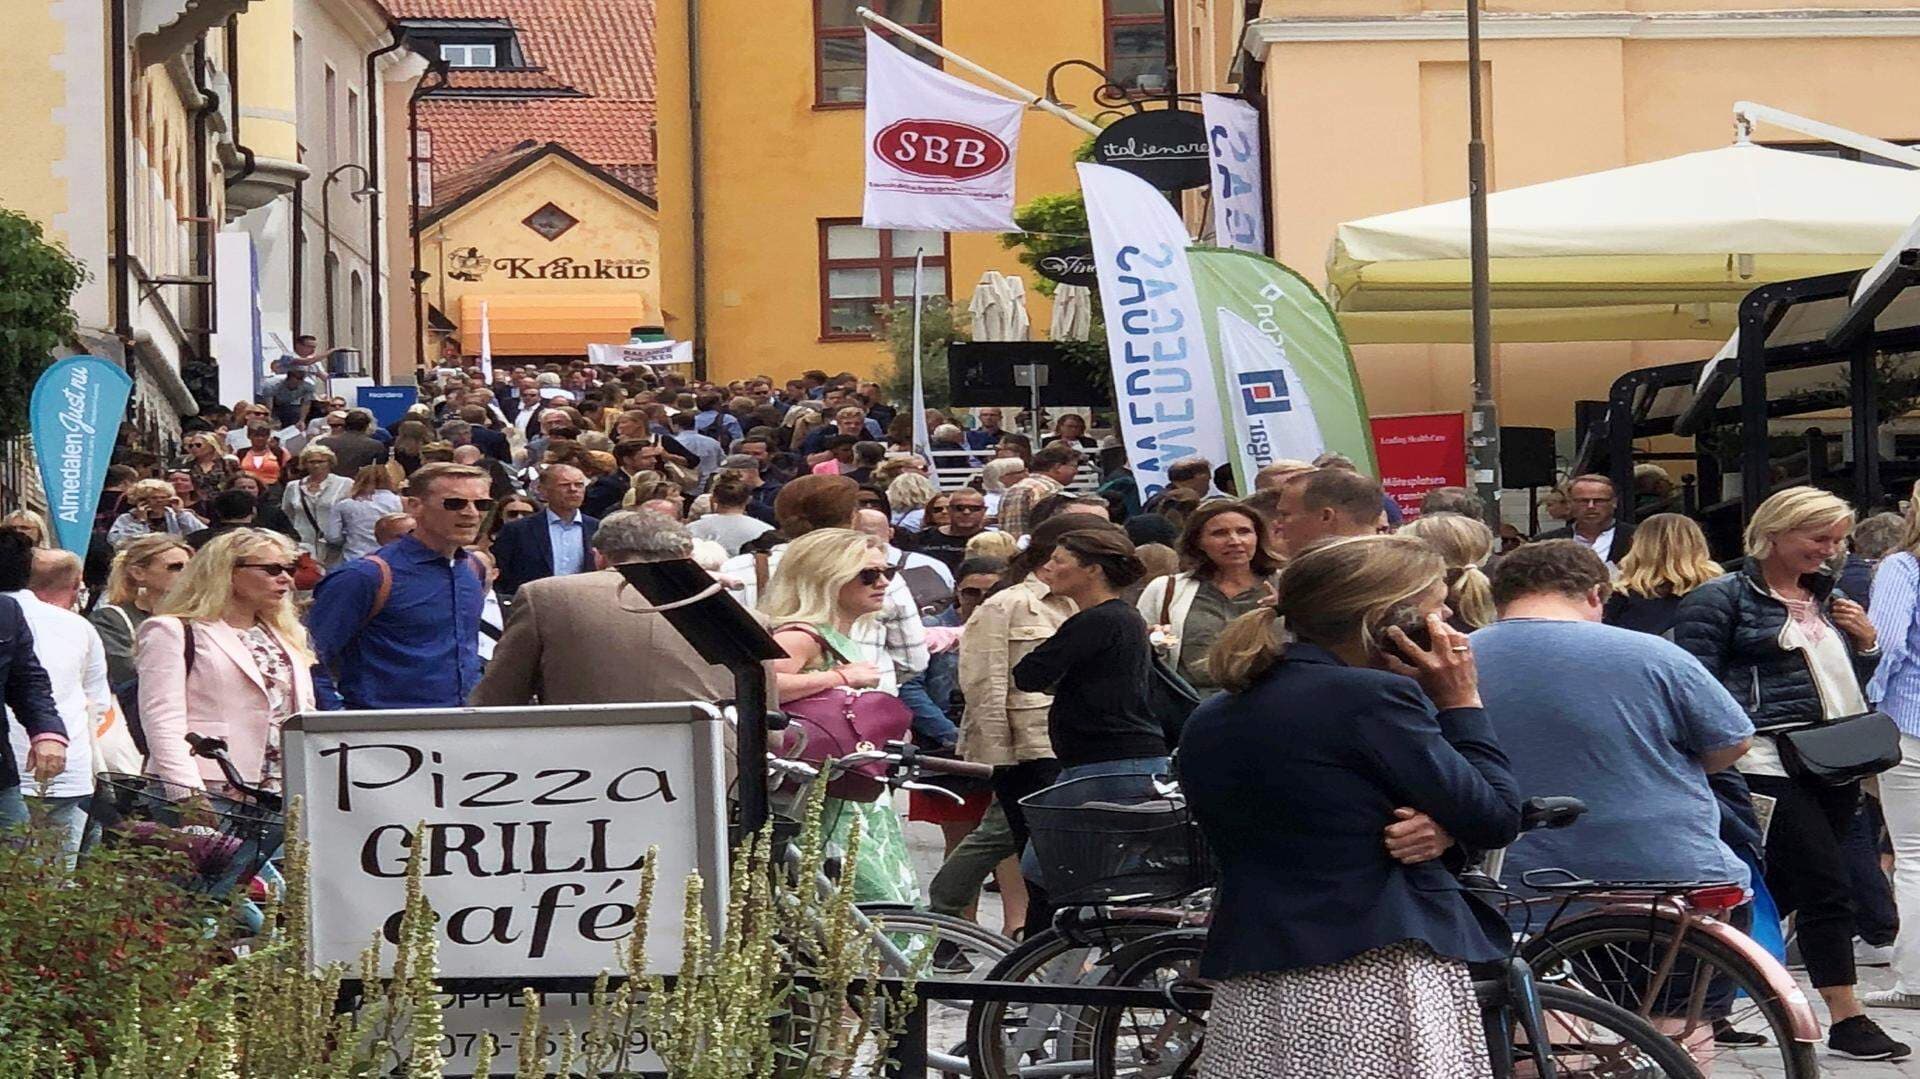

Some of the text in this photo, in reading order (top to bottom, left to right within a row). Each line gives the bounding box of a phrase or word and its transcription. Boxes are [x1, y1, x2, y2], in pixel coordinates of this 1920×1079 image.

[895, 131, 986, 168] SBB
[494, 256, 651, 280] Kränku
[58, 432, 84, 524] Almedalen
[319, 742, 678, 812] Pizza
[360, 818, 645, 878] GRILL
[383, 878, 633, 959] café
